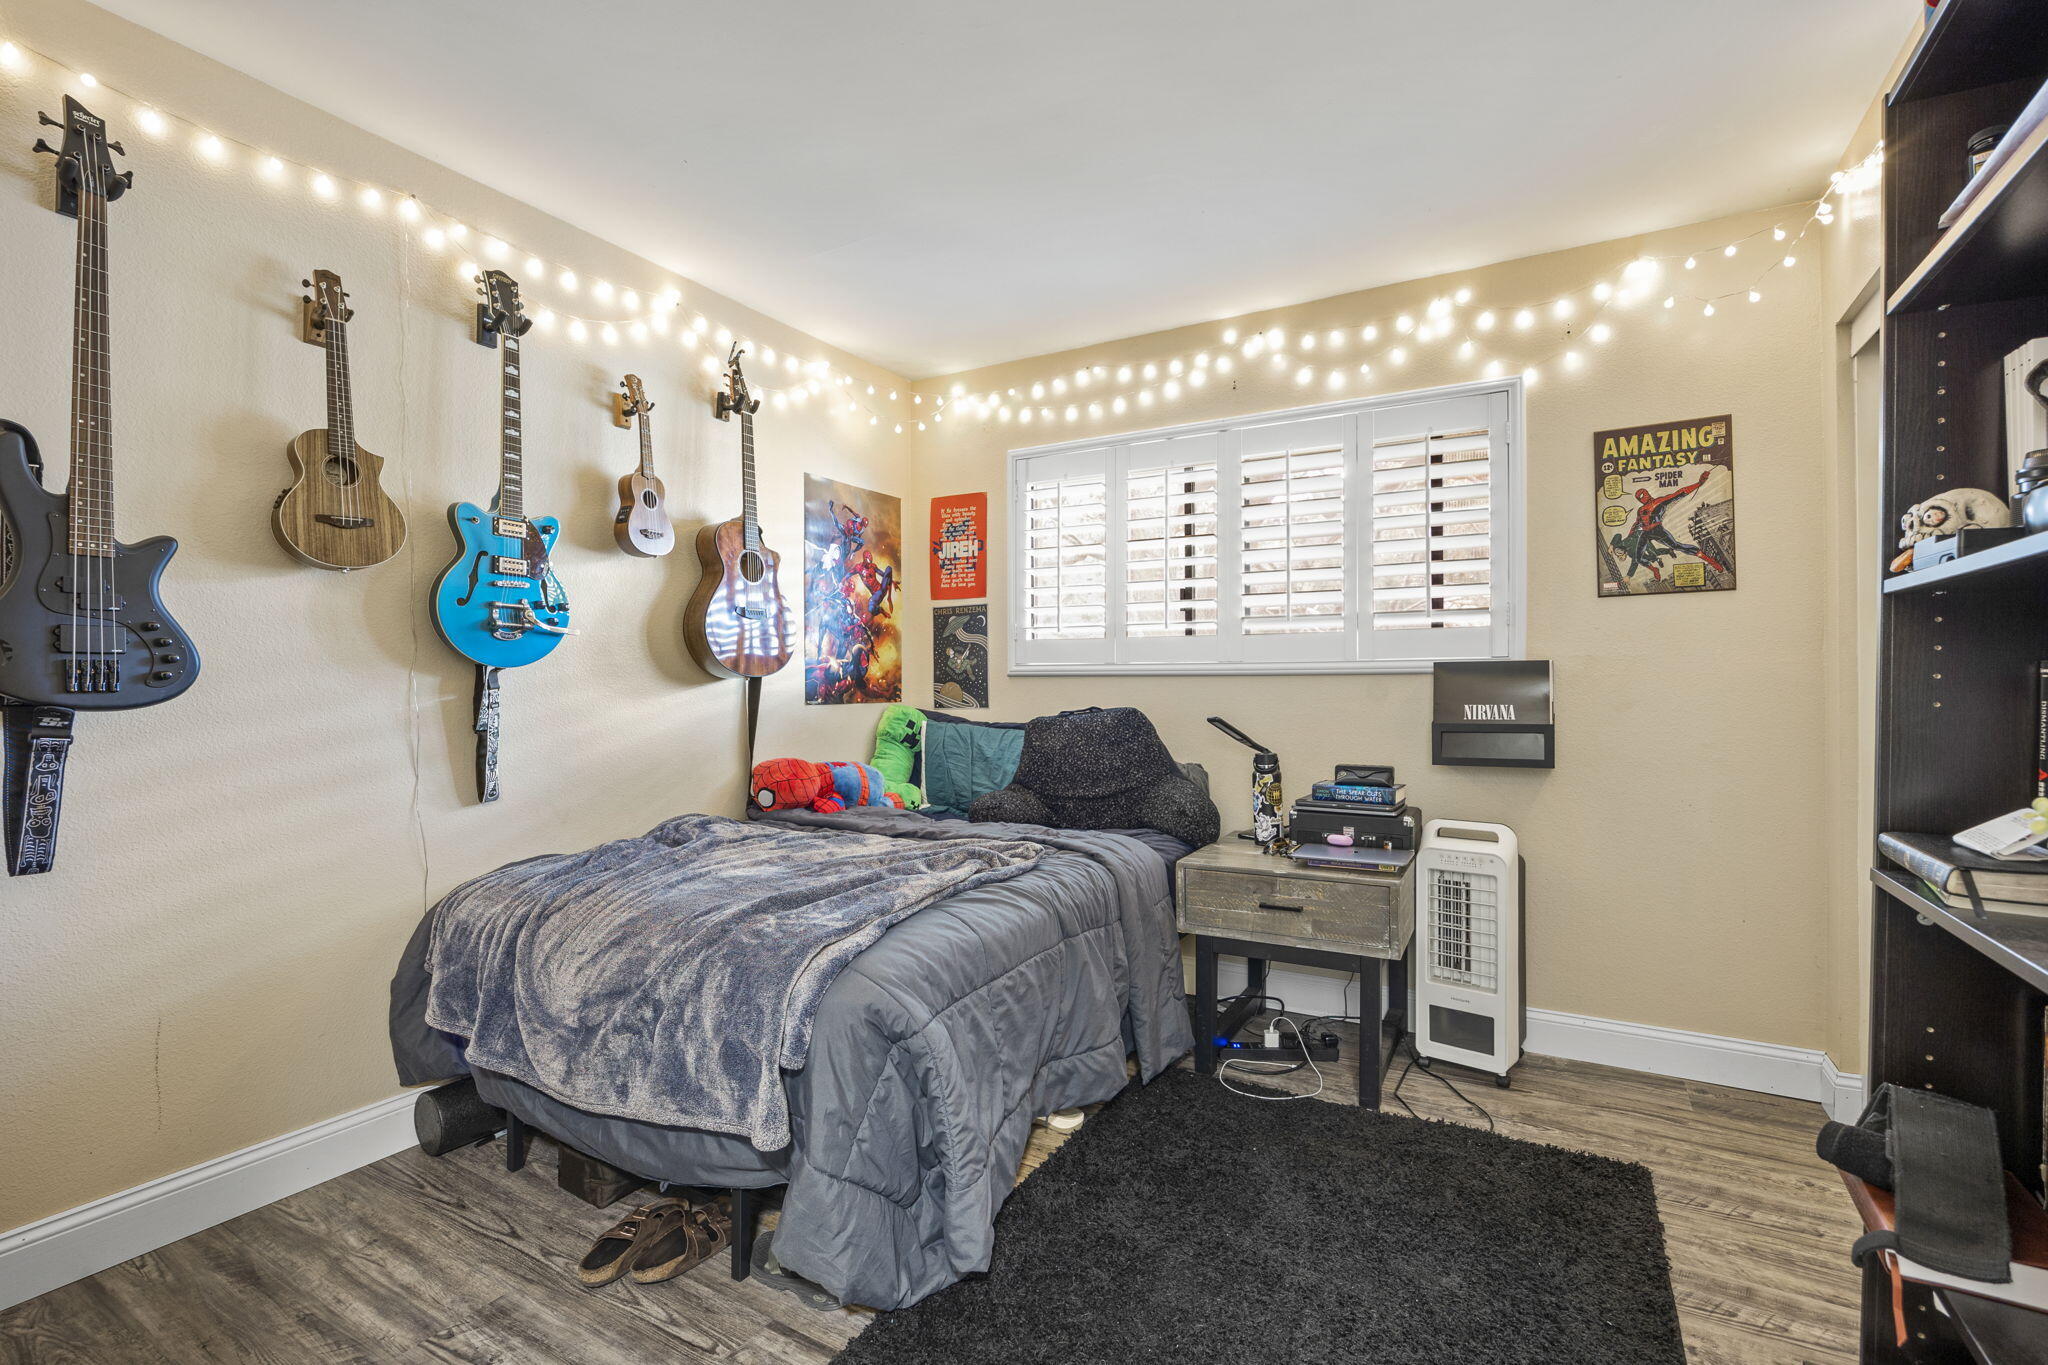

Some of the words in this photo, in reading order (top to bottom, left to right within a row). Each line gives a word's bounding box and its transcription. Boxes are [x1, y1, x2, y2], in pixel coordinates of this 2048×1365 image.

[1603, 426, 1715, 459] AMAZING
[1618, 451, 1698, 472] FANTASY
[1654, 471, 1683, 480] SPIDER
[1659, 479, 1679, 488] MAN
[938, 539, 978, 559] JIREH
[934, 608, 953, 616] CHRIS
[955, 606, 987, 614] RENZEMA
[1463, 704, 1516, 720] NIRVANA
